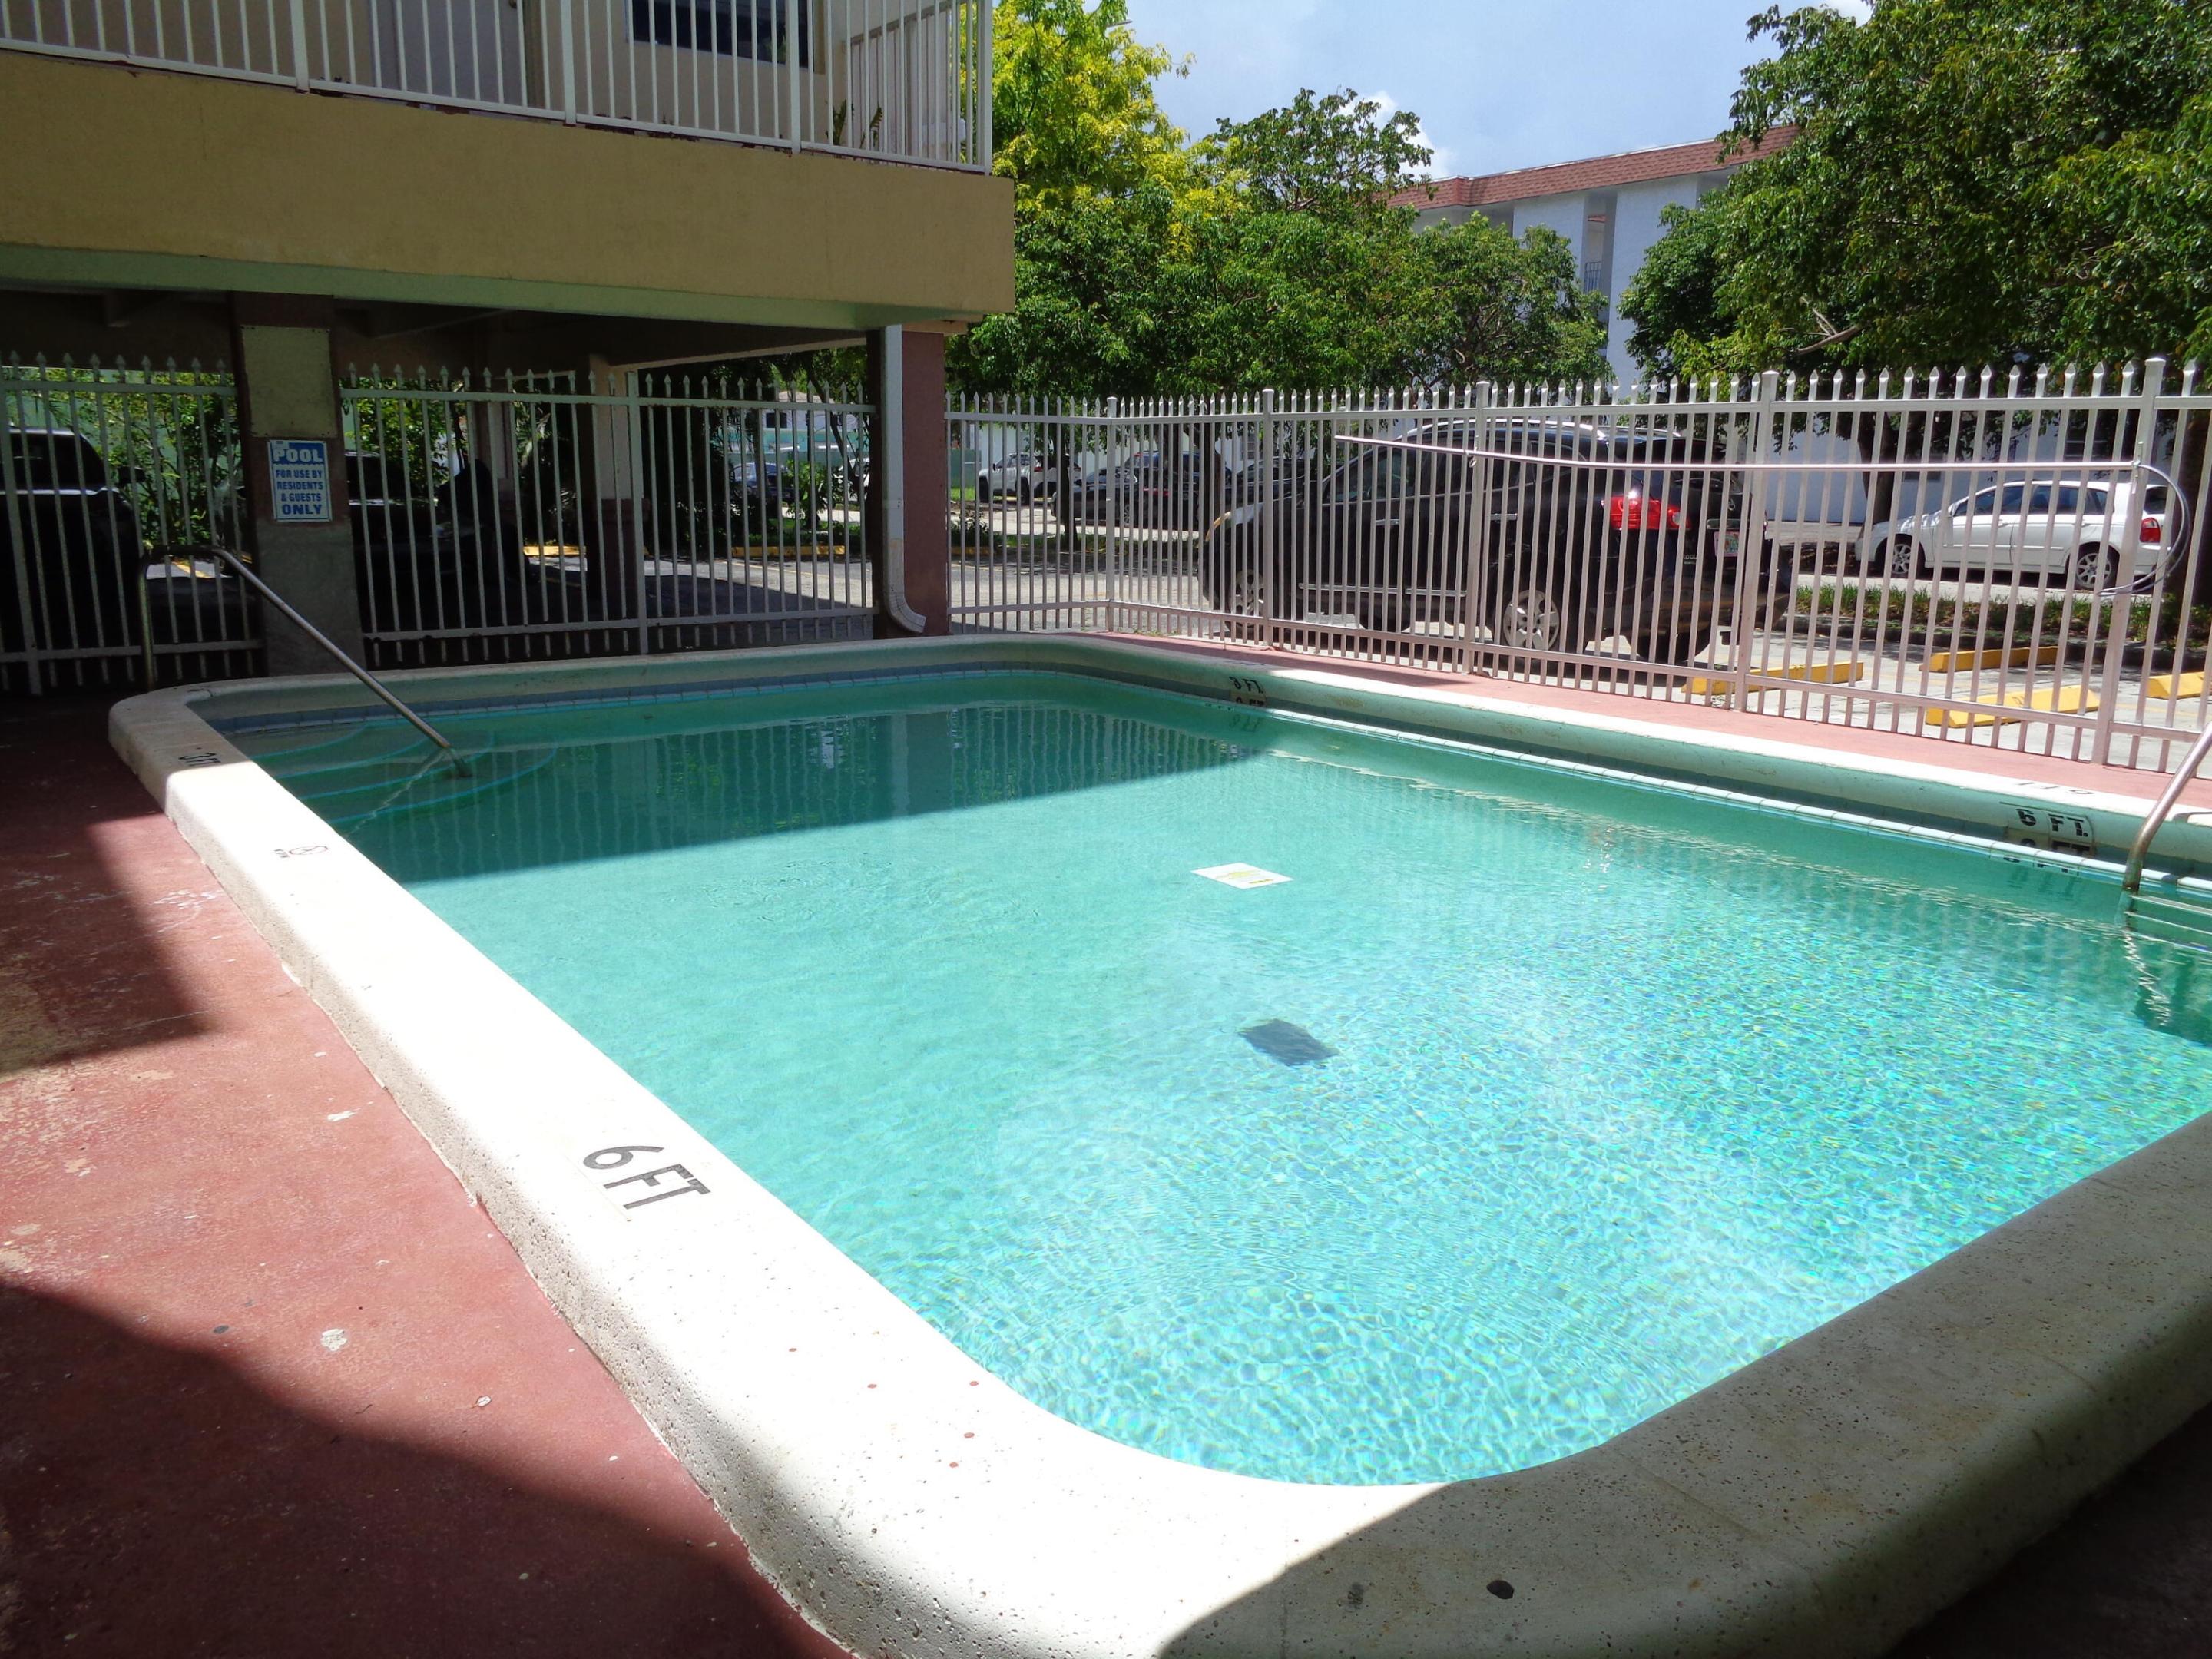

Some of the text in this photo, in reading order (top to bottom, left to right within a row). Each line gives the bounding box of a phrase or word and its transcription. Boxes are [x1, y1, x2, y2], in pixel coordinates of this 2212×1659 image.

[273, 449, 323, 462] POOL
[276, 469, 292, 478] FOR
[293, 470, 310, 478] USE
[276, 482, 323, 490] RESIDENTS
[289, 493, 322, 502] GUESTS
[282, 504, 322, 515] ONLY
